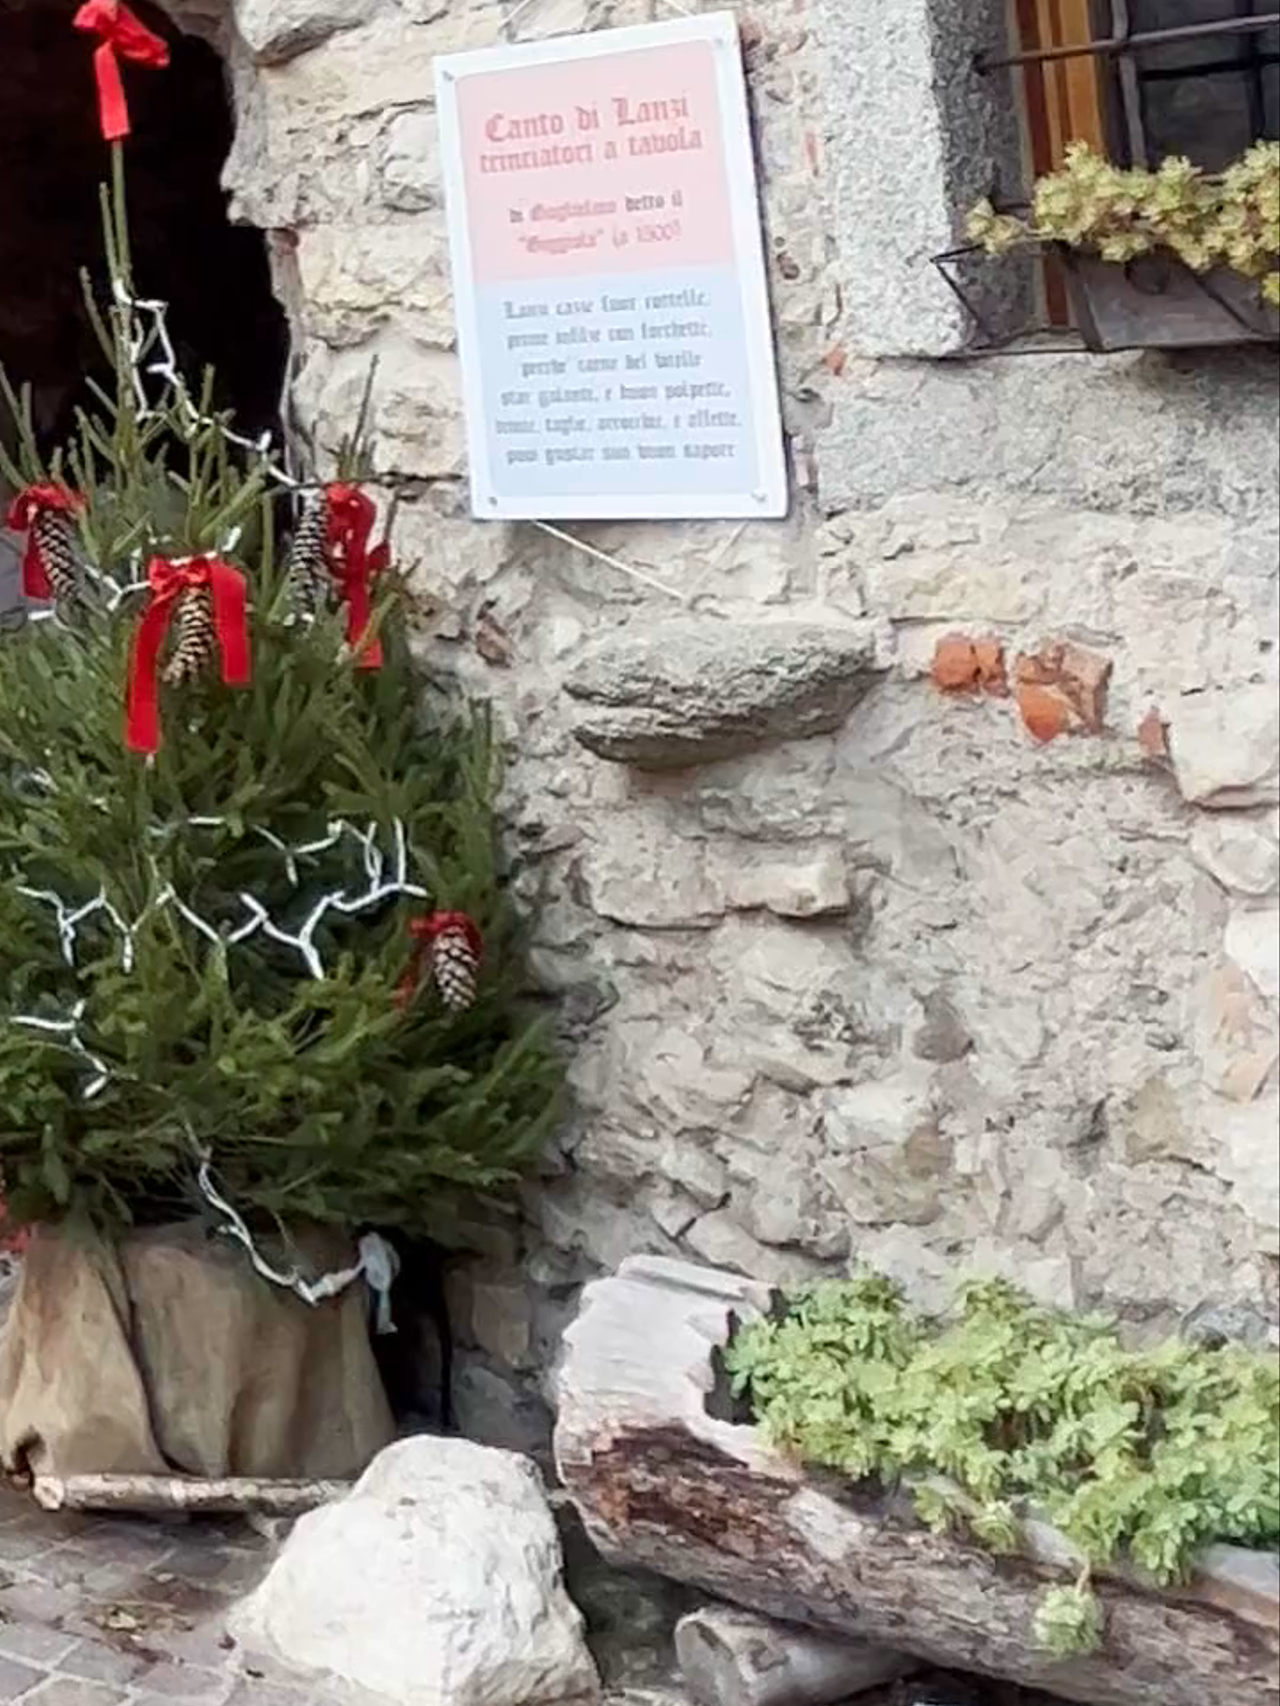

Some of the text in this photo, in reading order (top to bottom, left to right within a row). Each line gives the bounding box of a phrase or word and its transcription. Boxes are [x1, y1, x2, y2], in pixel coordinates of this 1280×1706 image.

[485, 93, 692, 143] Canto di Lanzi
[479, 126, 703, 174] trinciatori a tavola
[625, 193, 665, 214] detto
